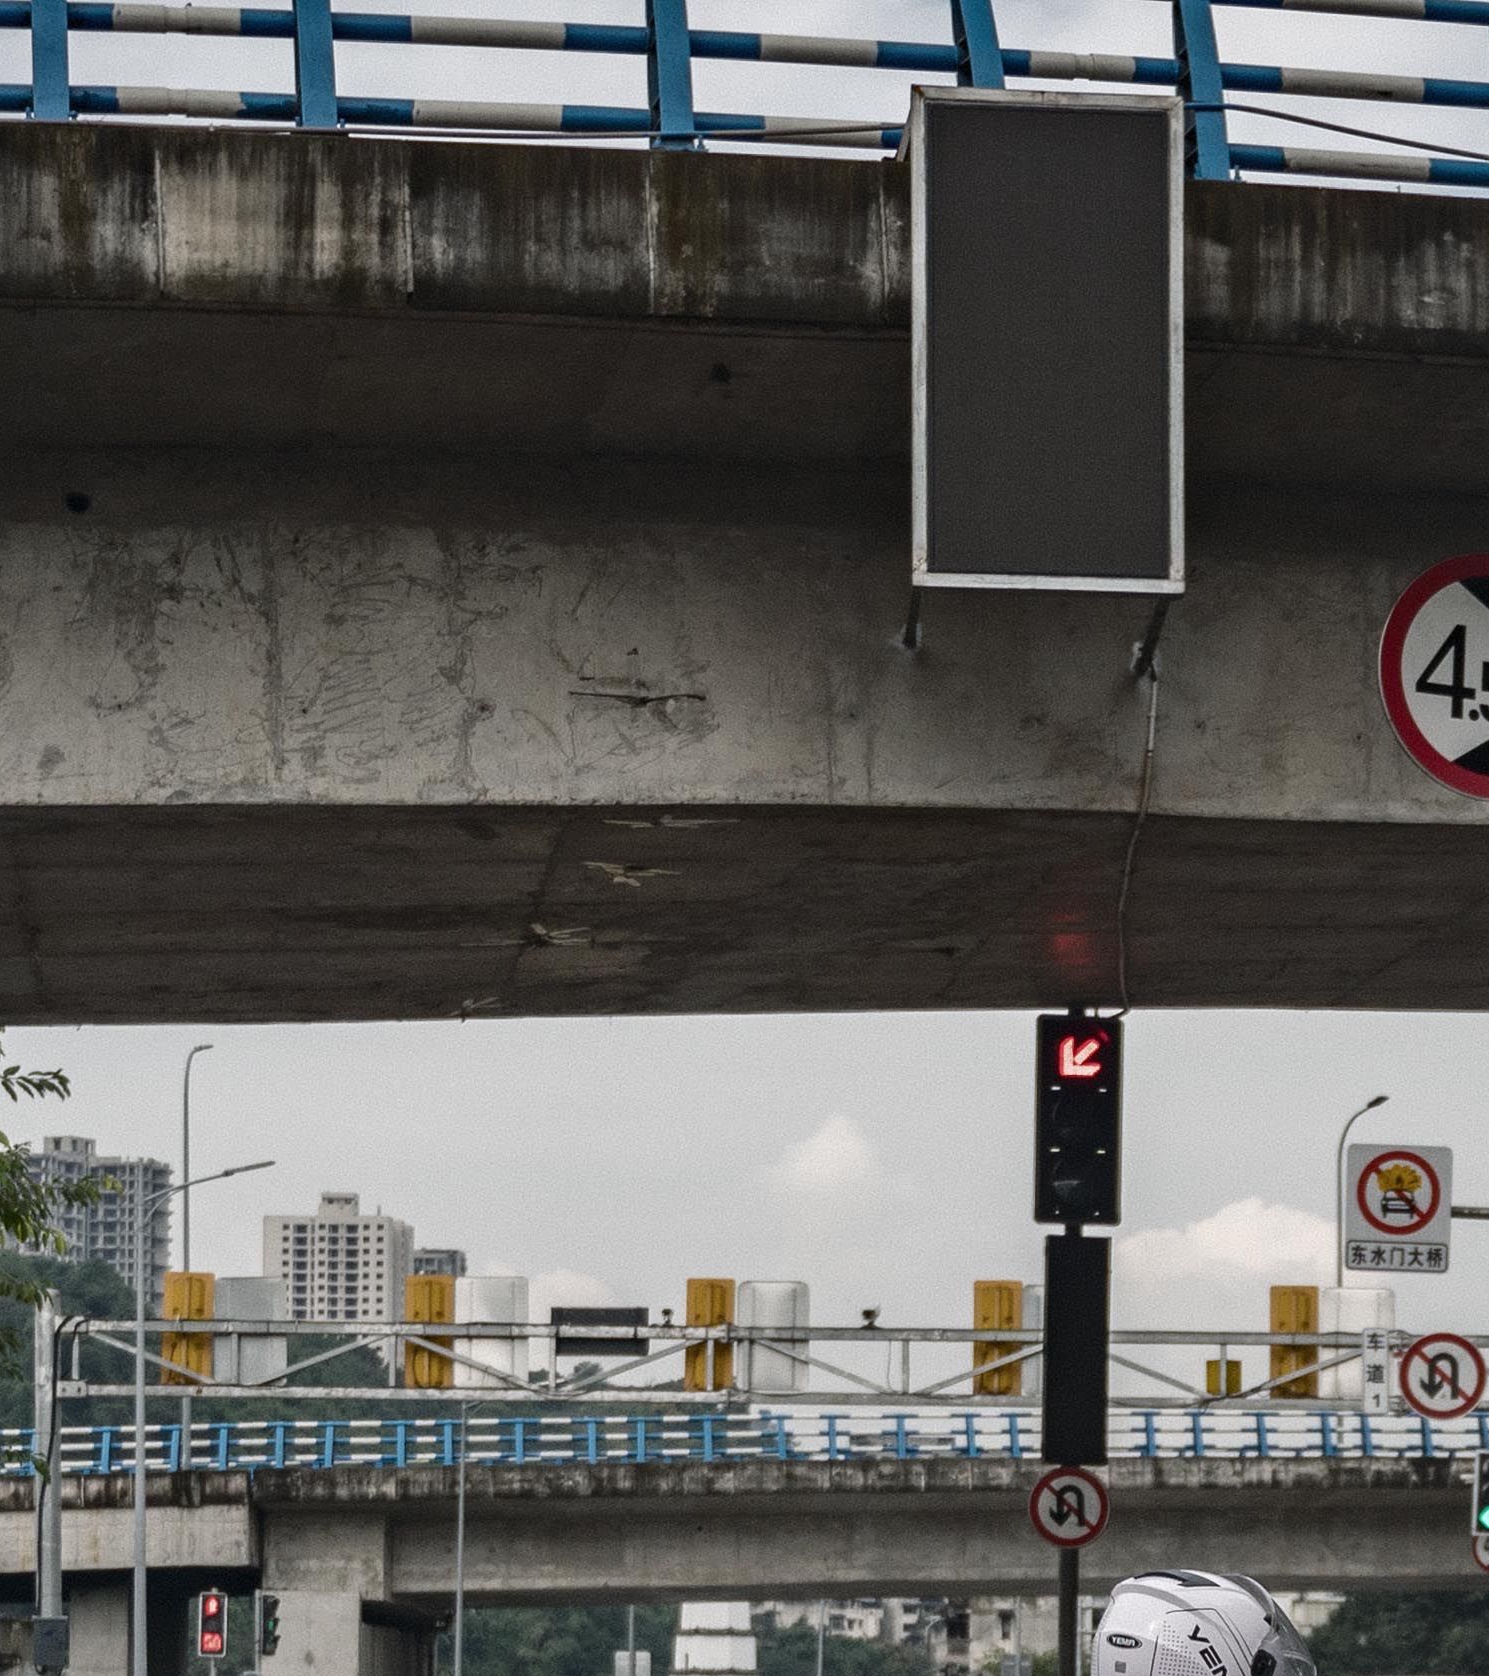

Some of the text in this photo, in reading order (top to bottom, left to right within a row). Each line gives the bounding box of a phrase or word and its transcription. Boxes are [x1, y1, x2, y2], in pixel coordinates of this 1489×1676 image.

[1351, 1245, 1444, 1269] 东水门大桥
